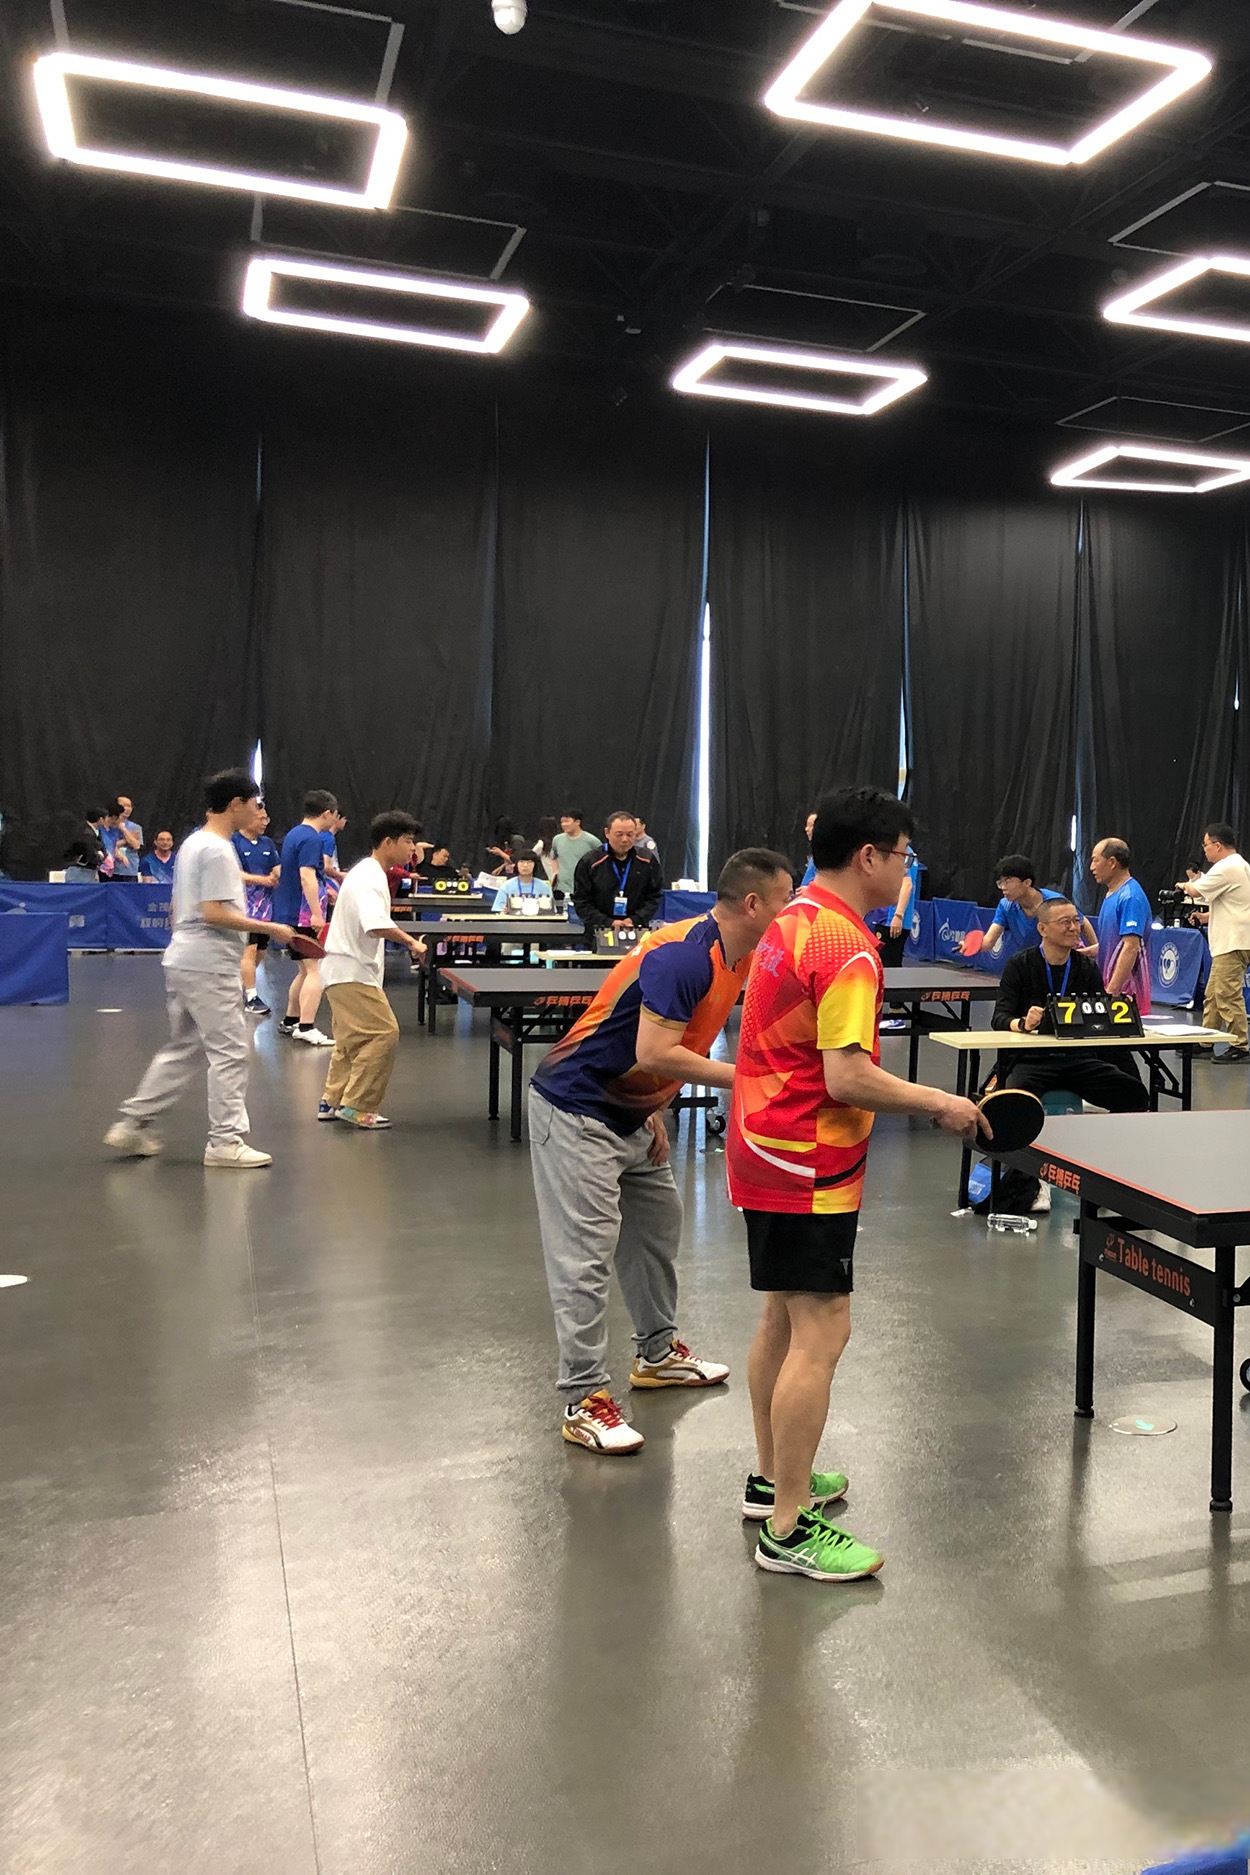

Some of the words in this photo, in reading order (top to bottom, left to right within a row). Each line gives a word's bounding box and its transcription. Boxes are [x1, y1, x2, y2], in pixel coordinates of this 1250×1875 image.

[1057, 1002, 1076, 1024] 7
[1111, 1001, 1132, 1023] 2
[1117, 1237, 1149, 1277] Table
[1151, 1256, 1191, 1297] tennis
